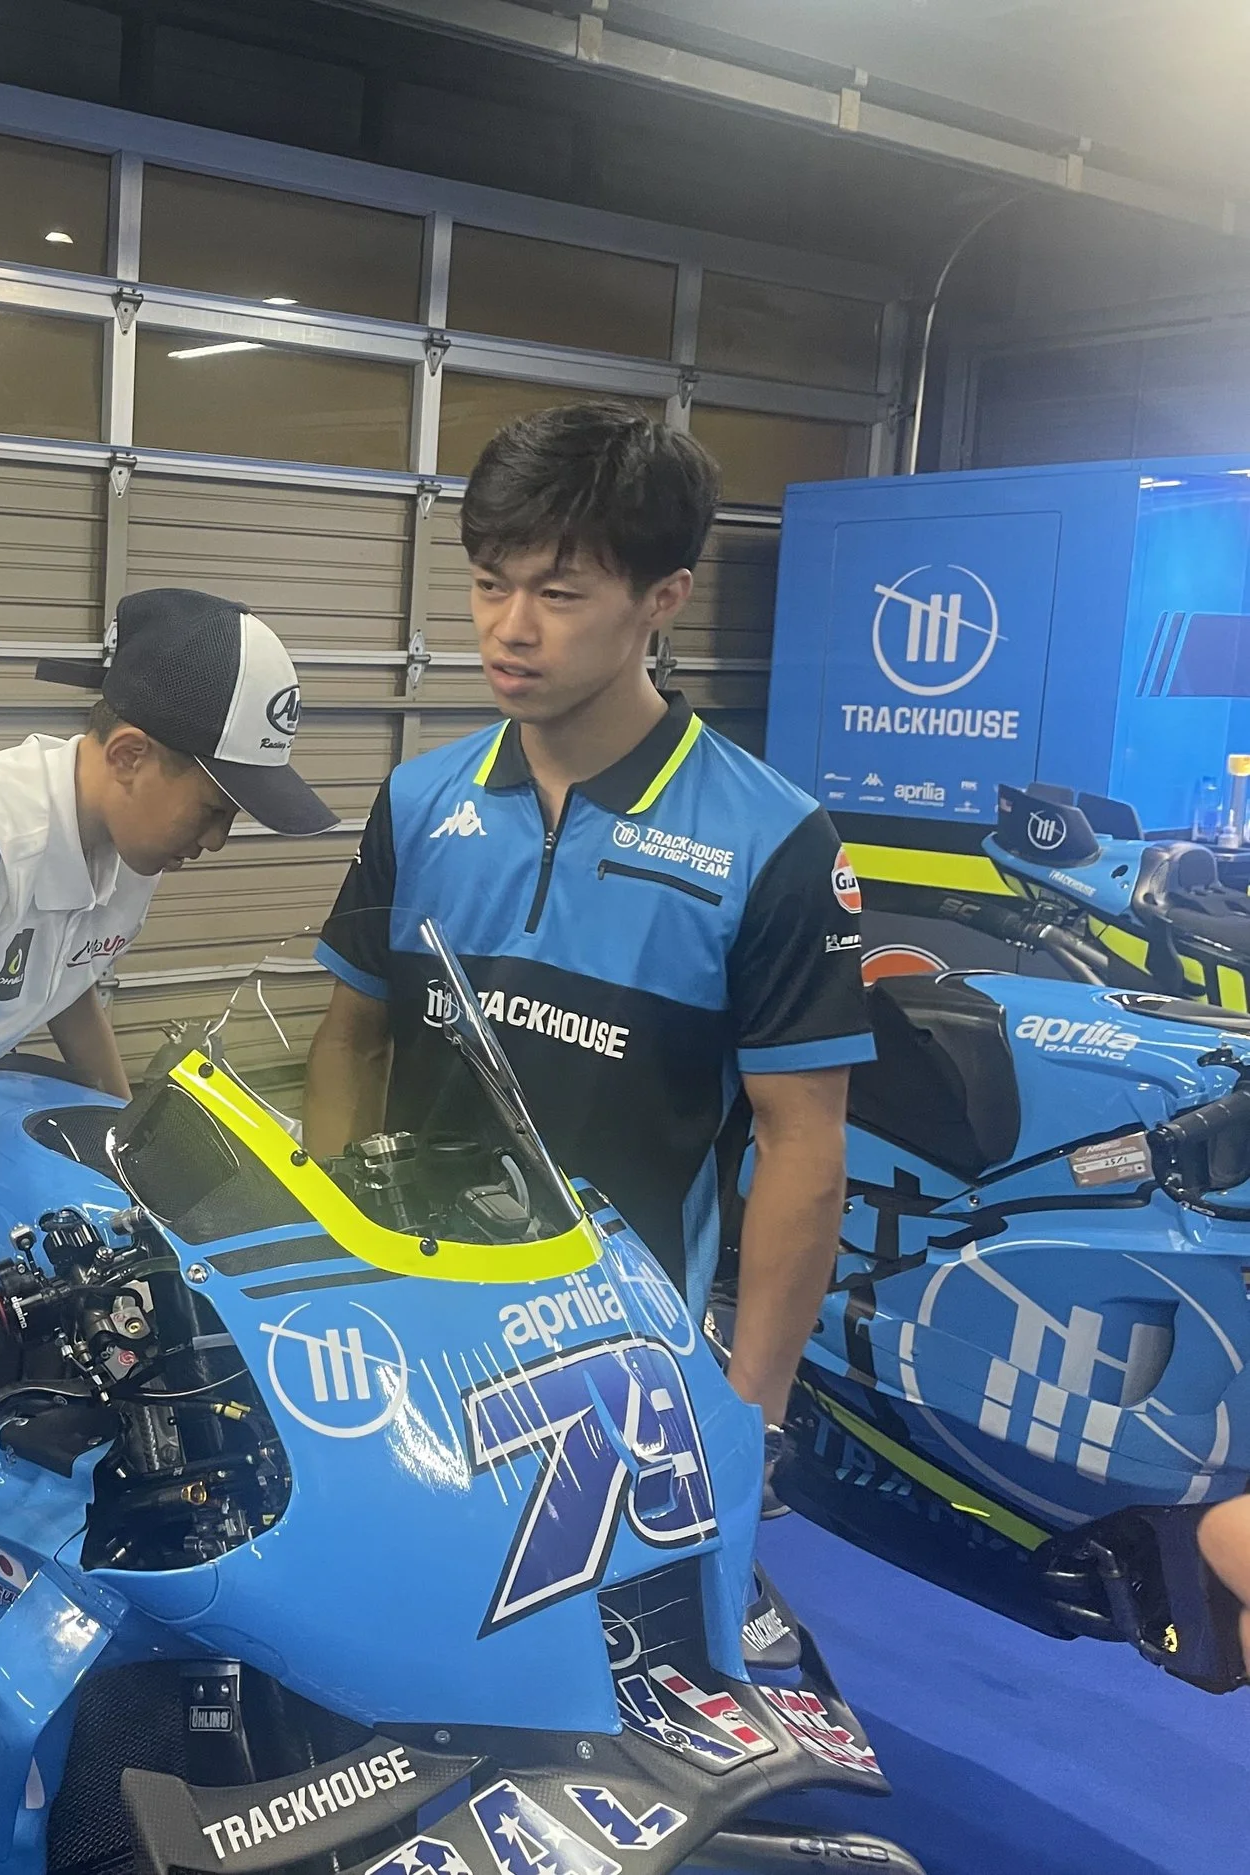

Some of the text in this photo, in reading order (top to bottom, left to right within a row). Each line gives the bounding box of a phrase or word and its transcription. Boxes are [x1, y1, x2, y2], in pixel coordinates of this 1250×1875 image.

[841, 704, 1020, 740] TRACKHOUSE
[893, 782, 946, 802] aprilia
[637, 841, 731, 879] MOTOGP TEAM
[644, 827, 735, 866] TRACKHOUSE
[467, 990, 630, 1060] ACKHOUSE
[1015, 1015, 1141, 1051] aprilia
[1044, 1044, 1127, 1061] RACING
[11, 1295, 28, 1329] domino
[499, 1272, 623, 1348] aprilia
[202, 1747, 417, 1860] TRACKHOUSE
